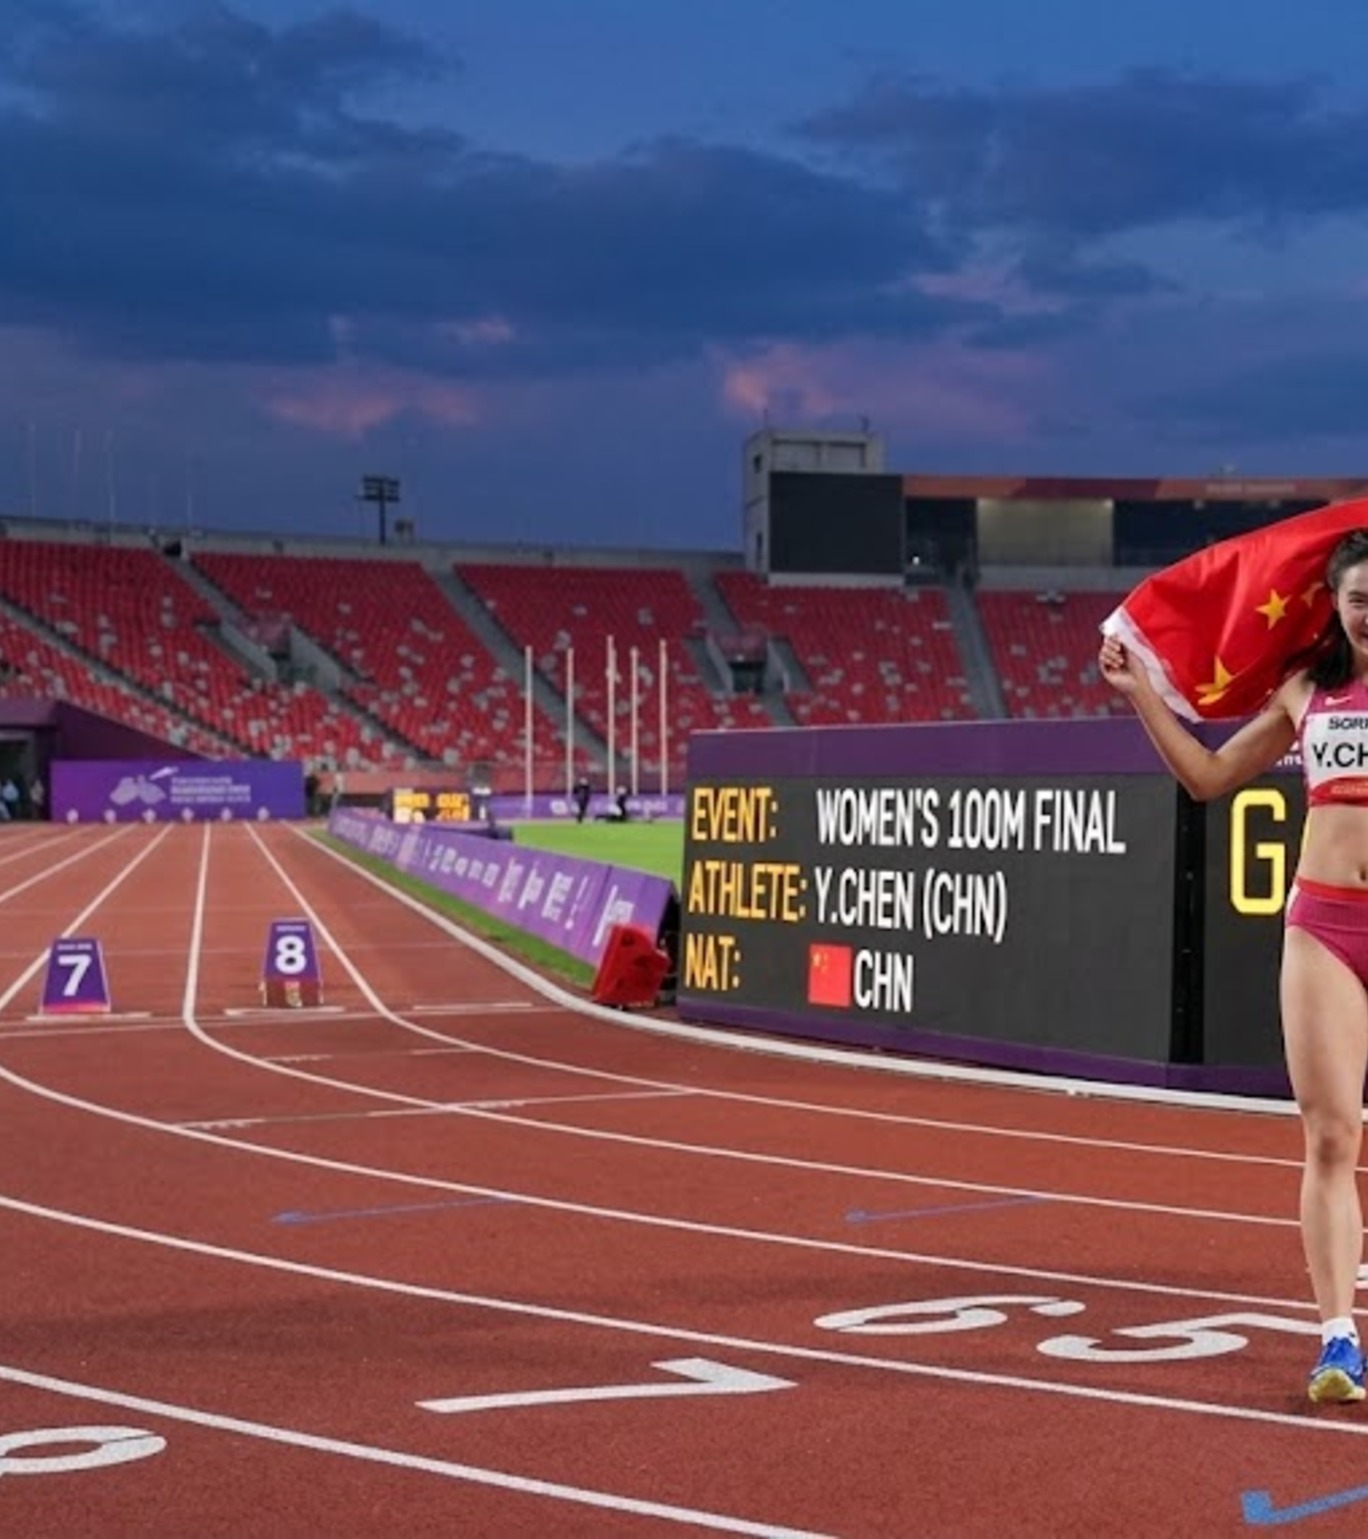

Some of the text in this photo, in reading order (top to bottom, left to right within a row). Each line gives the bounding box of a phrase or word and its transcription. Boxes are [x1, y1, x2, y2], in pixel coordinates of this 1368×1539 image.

[692, 787, 1127, 854] EVENT: WOMEN'S 100M FINAL
[688, 860, 807, 922] ATHLETE:
[814, 866, 915, 931] Y.CHEN
[922, 867, 1008, 943] (CHN)
[58, 954, 92, 996] 7
[275, 935, 307, 974] 8
[685, 933, 914, 1013] NAT: CHN
[813, 1295, 1087, 1335] 6
[1036, 1311, 1322, 1362] 5
[414, 1357, 799, 1413] 7
